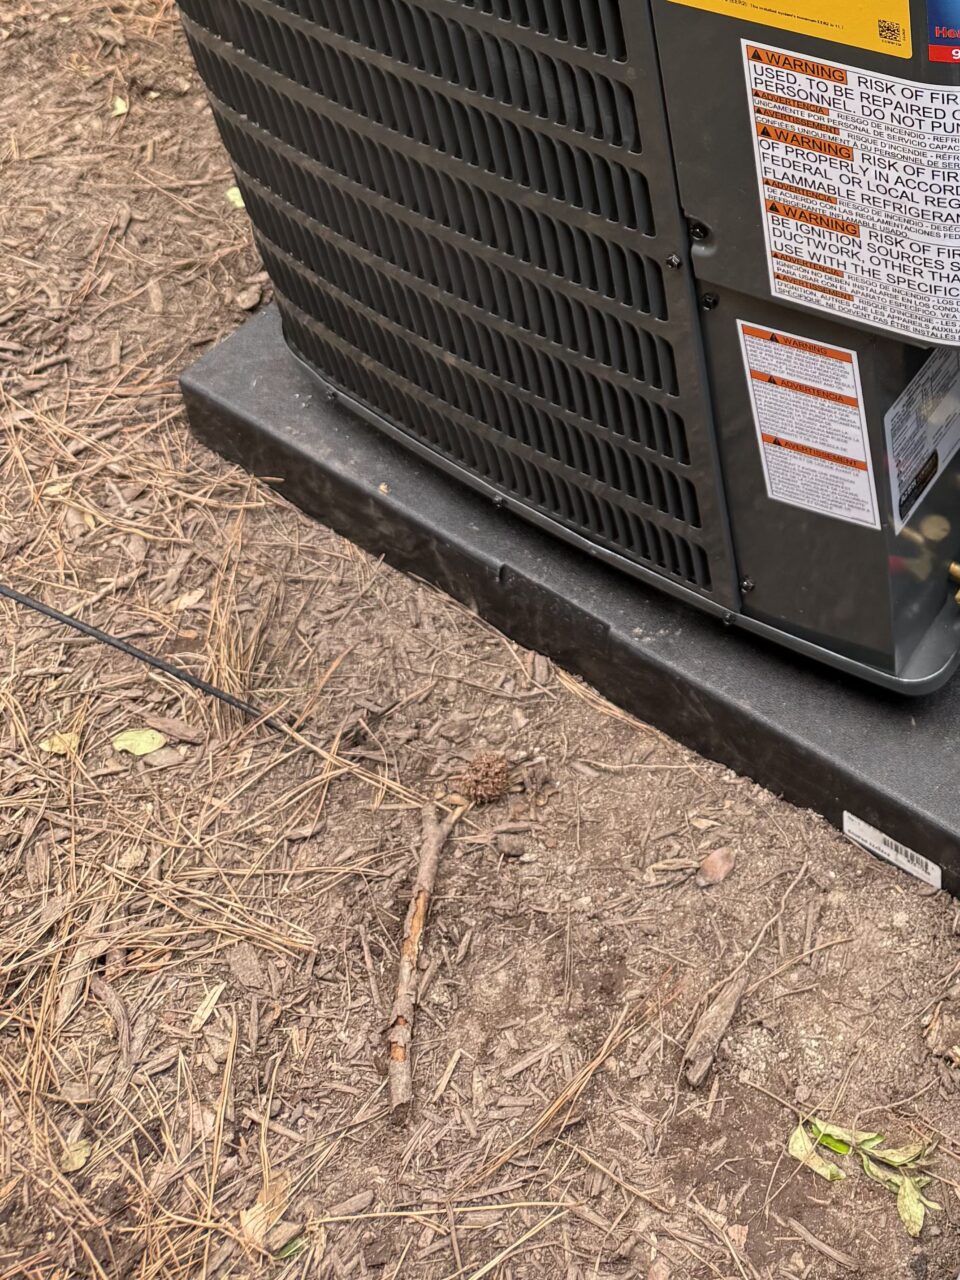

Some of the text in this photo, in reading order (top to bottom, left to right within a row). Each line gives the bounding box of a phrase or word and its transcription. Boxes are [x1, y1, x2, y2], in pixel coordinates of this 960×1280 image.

[754, 64, 801, 86] USED.
[806, 78, 828, 93] TO
[834, 85, 855, 100] BE
[860, 92, 946, 119] REPAIRED
[766, 52, 844, 81] WARNING
[858, 76, 896, 96] RISK
[901, 88, 924, 100] OF
[754, 77, 856, 114] PERSONNEL.
[862, 105, 885, 120] DO
[891, 112, 925, 130] NOT
[760, 139, 780, 152] OF
[785, 145, 869, 177] PROPERLY
[875, 170, 888, 184] IN
[762, 152, 833, 180] FEDERAL
[839, 174, 862, 188] OR
[867, 181, 919, 204] LOCAL
[775, 129, 851, 159] WARNING
[861, 153, 899, 172] RISK
[903, 165, 926, 177] OF
[764, 166, 856, 201] FLAMMABLE
[772, 215, 790, 229] BE
[796, 222, 862, 249] IGNITION
[867, 242, 945, 270] SOURCES
[773, 228, 865, 264] DUCTWORK,
[869, 256, 924, 279] OTHER
[783, 205, 857, 235] WARNING
[869, 230, 905, 249] RISK
[910, 242, 931, 255] OF
[774, 241, 804, 258] USE
[808, 250, 847, 270] WITH
[851, 262, 880, 280] THE
[886, 273, 960, 298] SPECIFIC
[784, 337, 828, 355] WARNING
[781, 380, 844, 402] ADVERTENCIA
